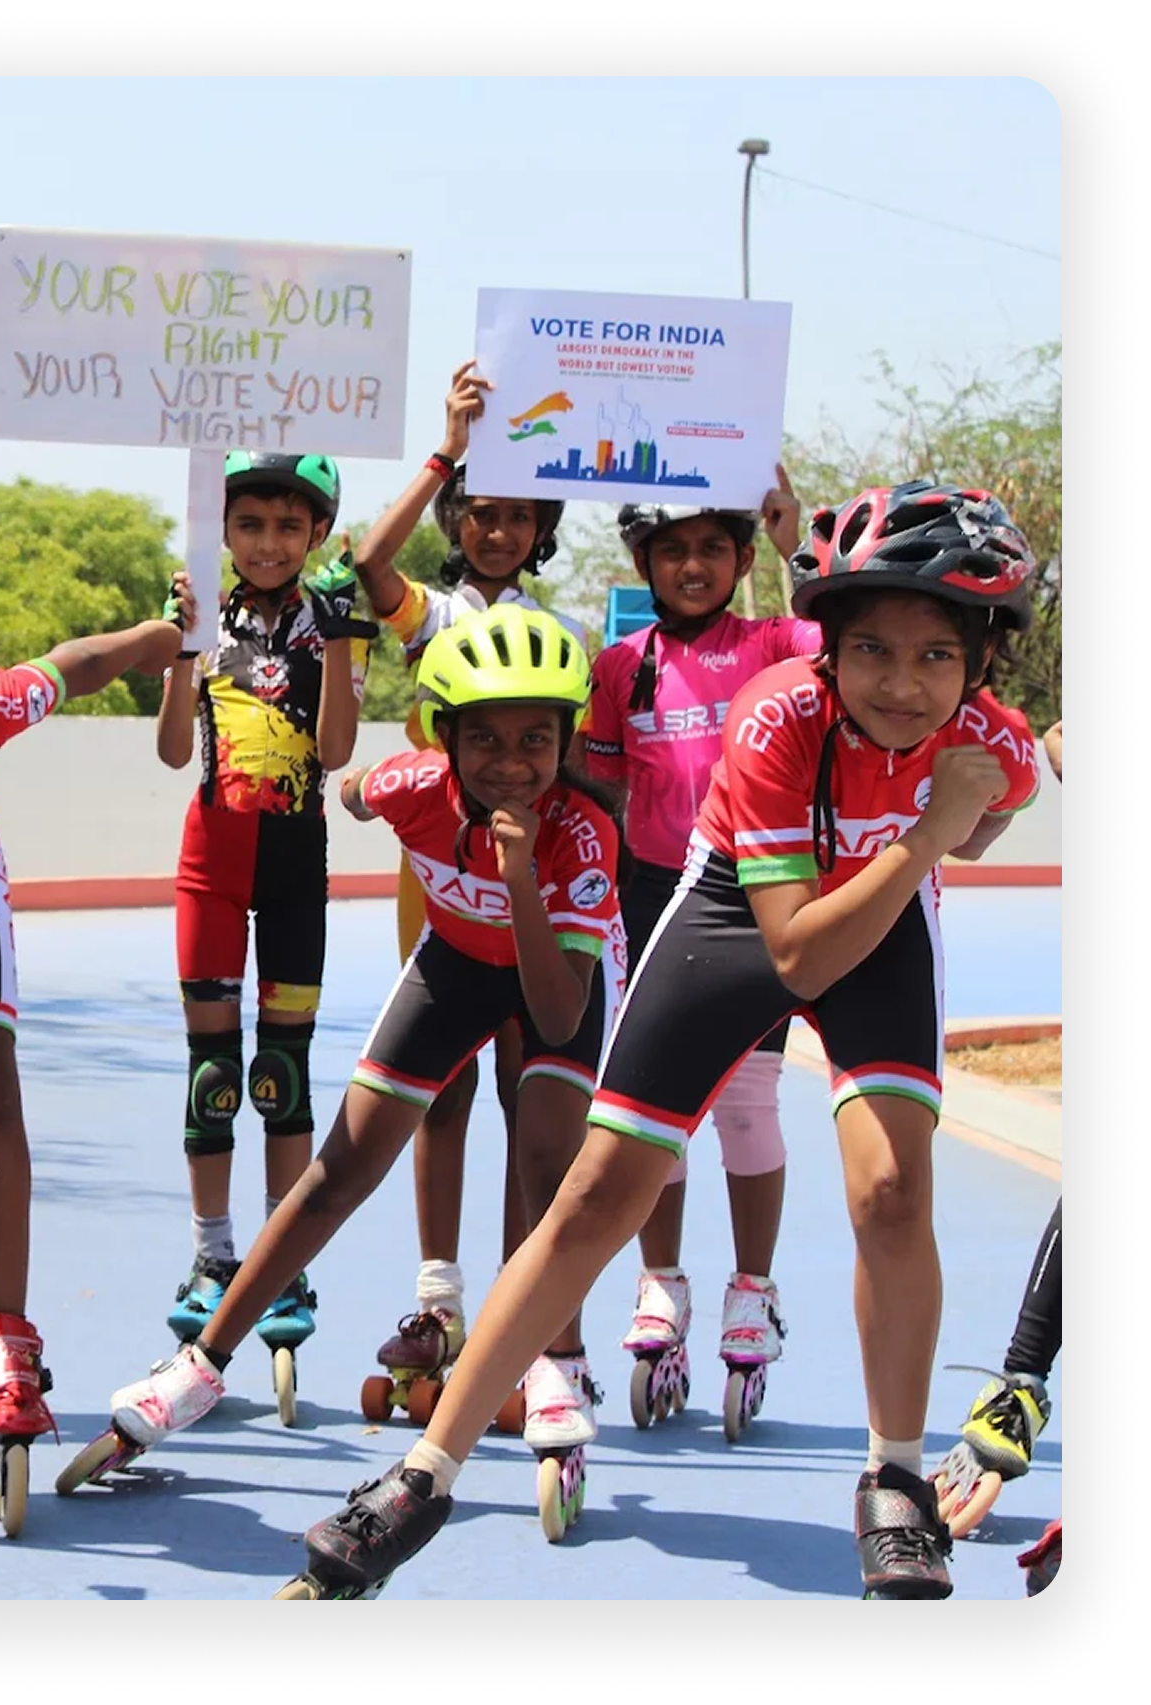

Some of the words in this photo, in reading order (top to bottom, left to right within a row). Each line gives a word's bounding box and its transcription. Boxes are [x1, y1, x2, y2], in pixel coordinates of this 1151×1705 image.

[14, 254, 137, 318] YOUR
[154, 270, 250, 320] VOTE
[262, 276, 373, 329] YOUR
[164, 322, 288, 366] RIGHT
[530, 317, 594, 340] VOTE
[602, 321, 651, 342] FOR
[659, 325, 726, 347] INDIA
[557, 343, 598, 355] LARGEST
[600, 346, 660, 359] DEMOCRACY
[662, 350, 675, 359] IN
[677, 351, 695, 360] THE
[14, 351, 122, 399] YOUR
[150, 368, 255, 410] VOTE
[265, 370, 381, 419] YOUR
[558, 358, 593, 370] WORLD
[596, 360, 614, 371] BUT
[617, 362, 654, 374] LOWEST
[656, 364, 695, 376] VOTING
[159, 409, 295, 447] MIGHT
[736, 683, 820, 752] 2018
[956, 703, 1039, 780] RAR
[410, 855, 512, 912] RAR
